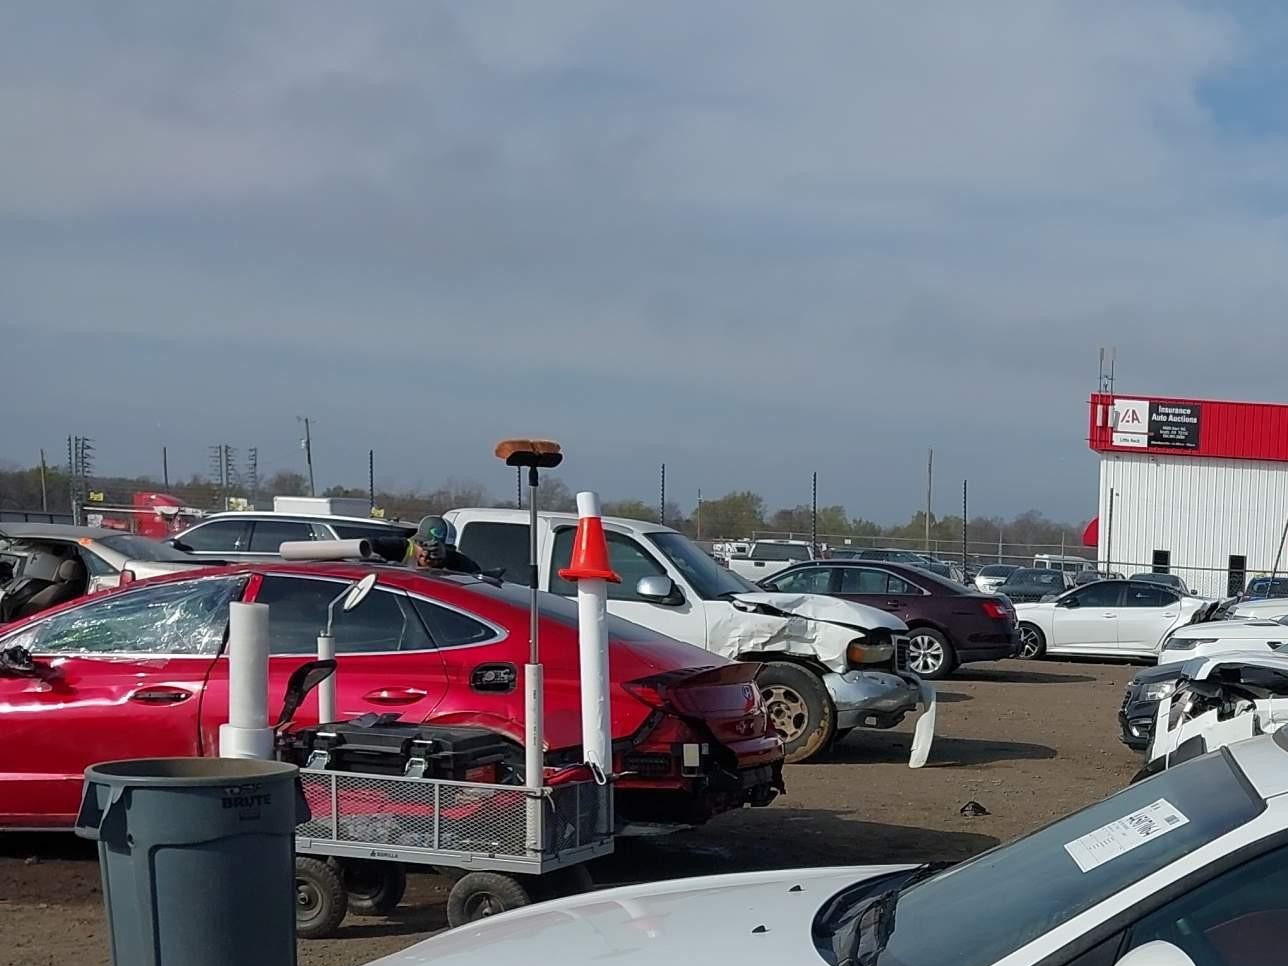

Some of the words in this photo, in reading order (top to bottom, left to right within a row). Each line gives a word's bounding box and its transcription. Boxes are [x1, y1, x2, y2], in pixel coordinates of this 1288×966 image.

[1158, 405, 1191, 414] Insurance
[1152, 413, 1167, 422] Auto
[1168, 414, 1198, 424] Auctions
[222, 793, 272, 808] BRUTE
